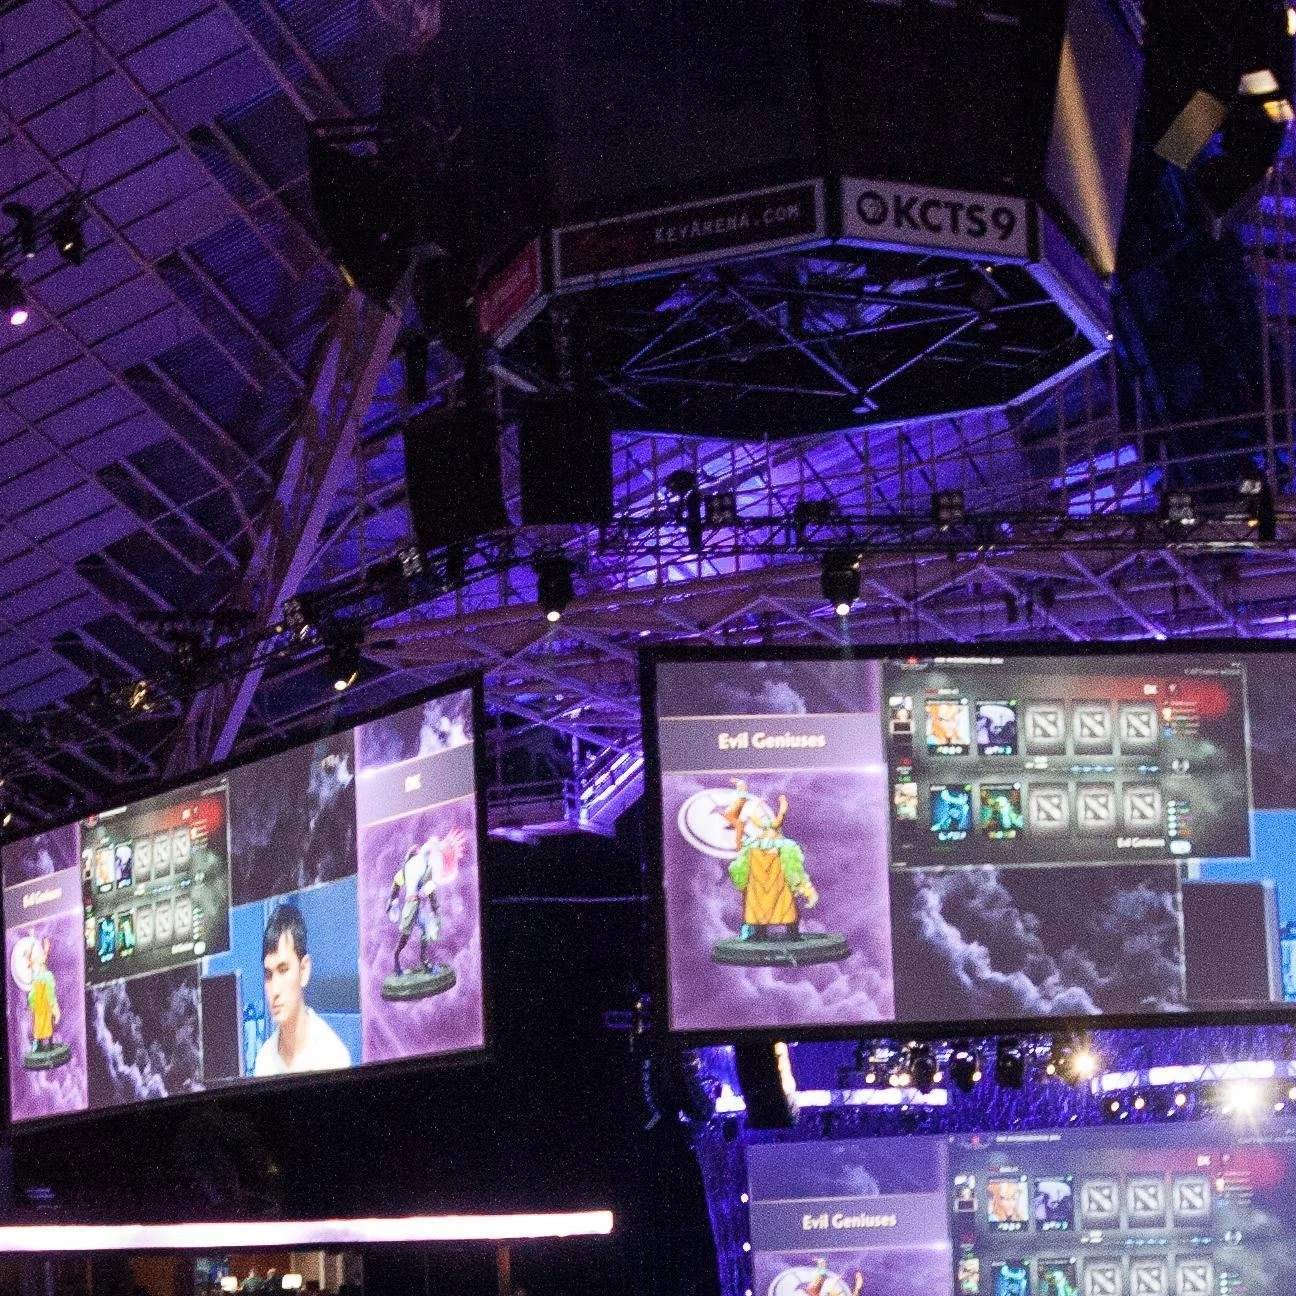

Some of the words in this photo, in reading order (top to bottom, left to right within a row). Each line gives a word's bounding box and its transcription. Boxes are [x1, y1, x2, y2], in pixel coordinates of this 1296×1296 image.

[718, 731, 749, 750] Evil
[751, 731, 827, 749] Geniuses
[803, 1212, 829, 1230] Evil
[832, 1213, 897, 1229] Geniuses
